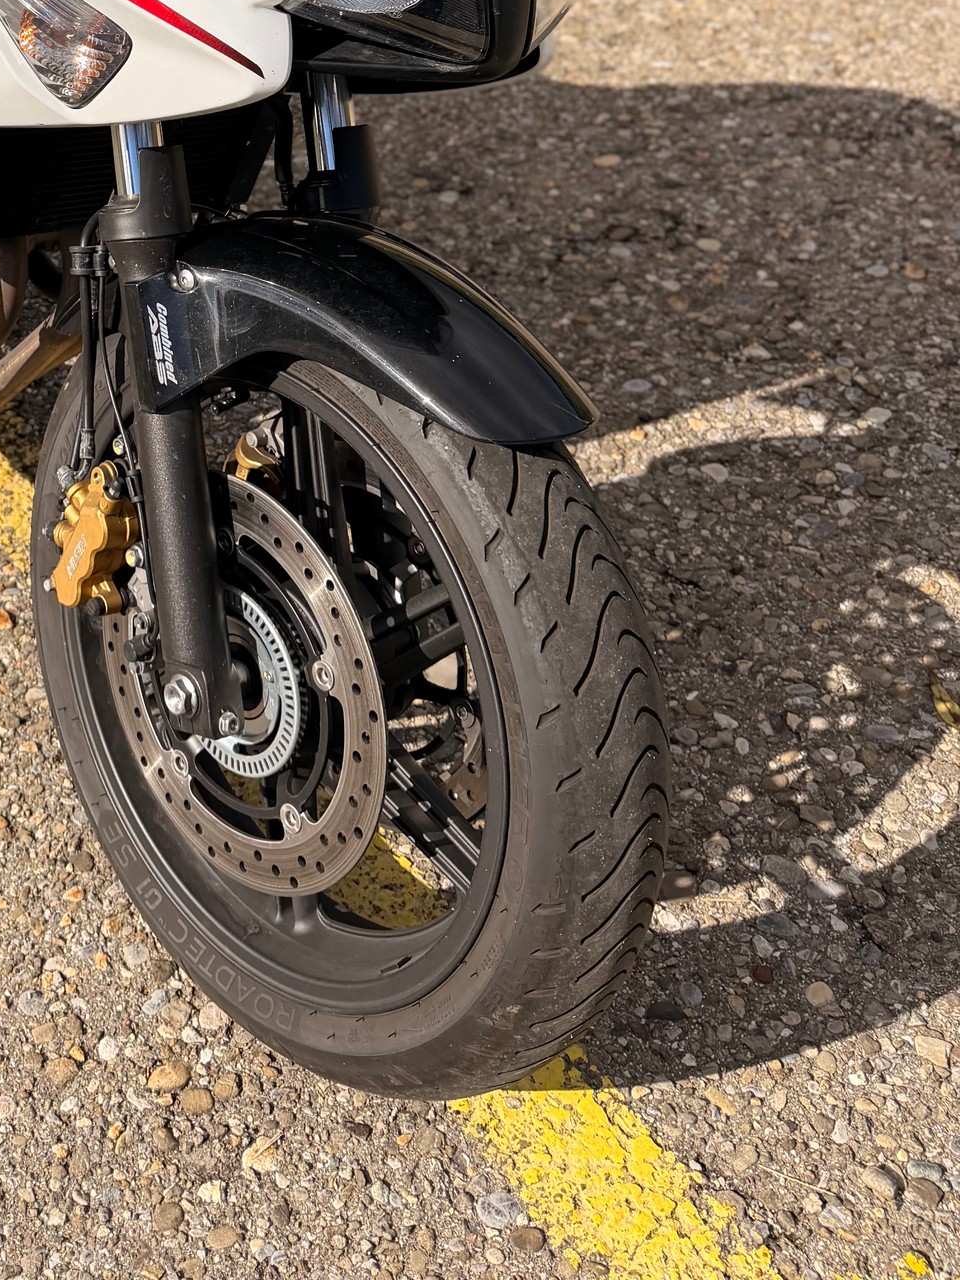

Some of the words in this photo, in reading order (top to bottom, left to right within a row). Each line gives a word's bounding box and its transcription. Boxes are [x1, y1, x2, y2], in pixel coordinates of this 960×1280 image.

[146, 304, 168, 386] ABS
[155, 302, 178, 385] Combined
[104, 821, 138, 869] SE
[135, 877, 163, 910] 01
